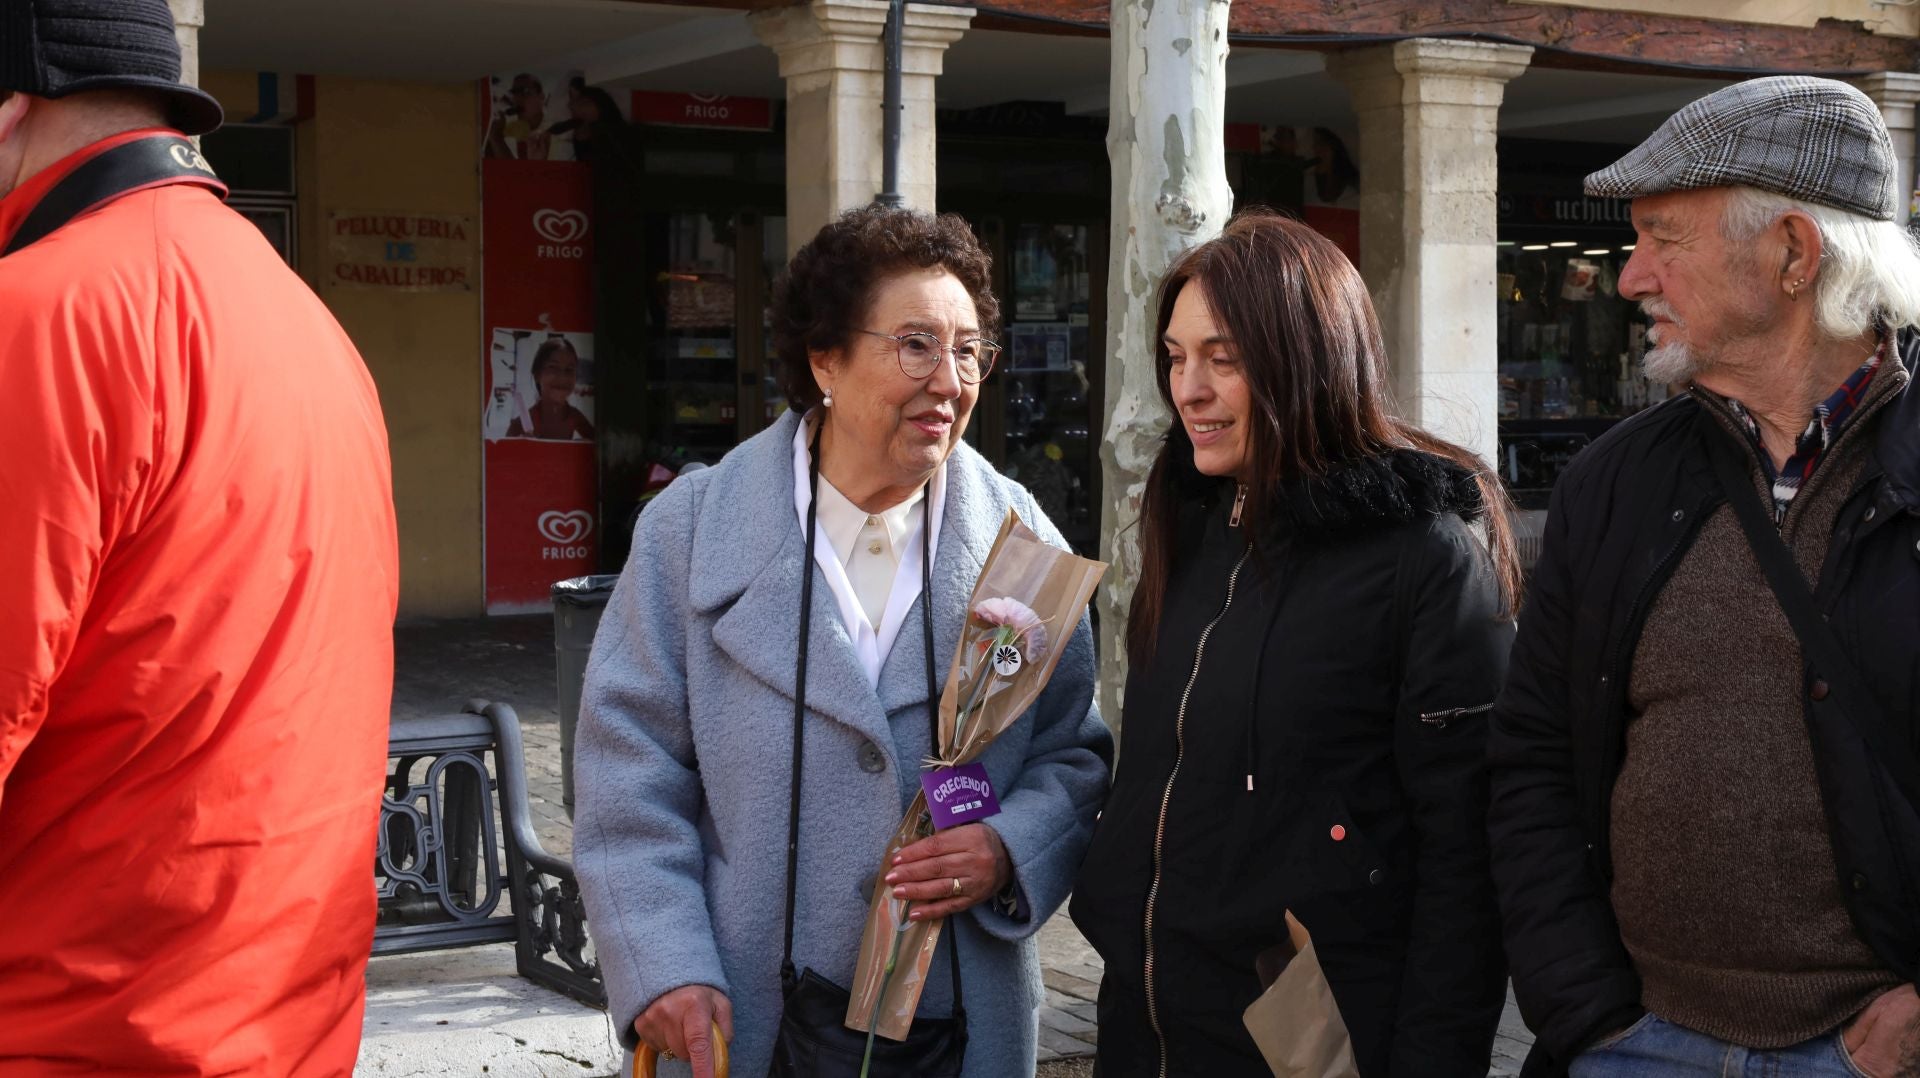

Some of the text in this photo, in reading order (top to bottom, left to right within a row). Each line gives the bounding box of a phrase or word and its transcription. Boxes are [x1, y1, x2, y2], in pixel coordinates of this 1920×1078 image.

[685, 104, 729, 120] FRIGO
[335, 215, 466, 241] PELUQUERIA
[384, 240, 417, 262] DE
[537, 245, 583, 259] FRIGO
[335, 262, 466, 286] CABALLEROS
[542, 545, 588, 560] FRIGO
[933, 775, 990, 803] CRECIENDO
